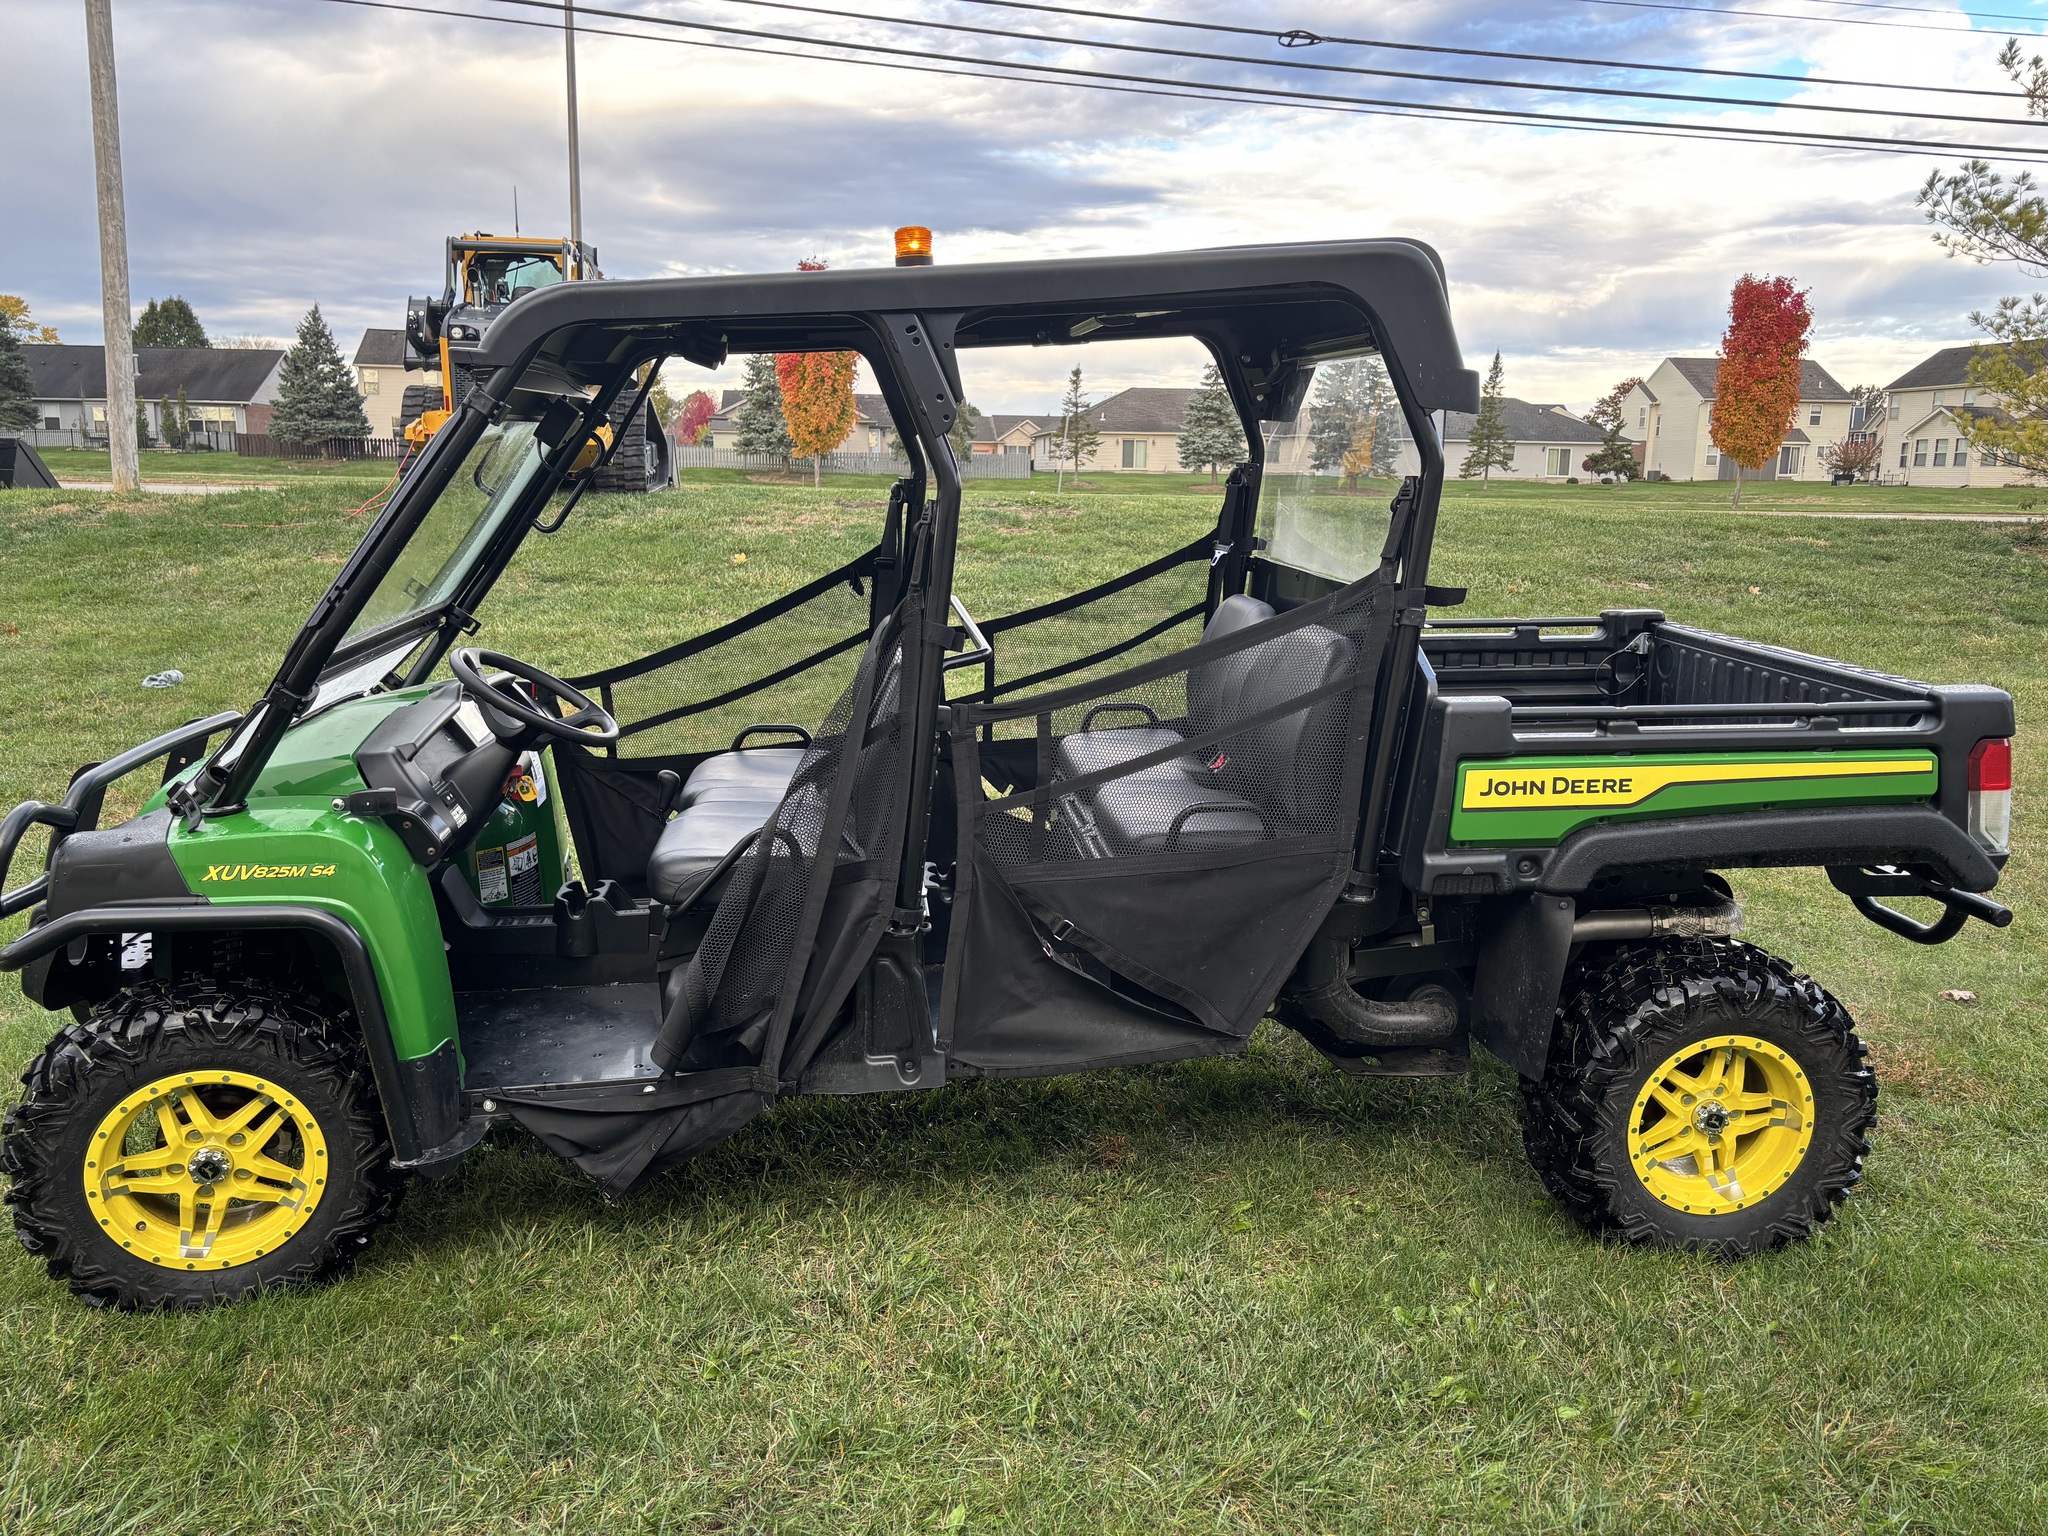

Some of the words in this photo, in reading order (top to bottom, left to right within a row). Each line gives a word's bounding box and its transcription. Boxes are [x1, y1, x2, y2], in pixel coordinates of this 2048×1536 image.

[1480, 778, 1545, 797] JOHN
[1552, 777, 1632, 795] DEERE
[310, 864, 337, 877] S4
